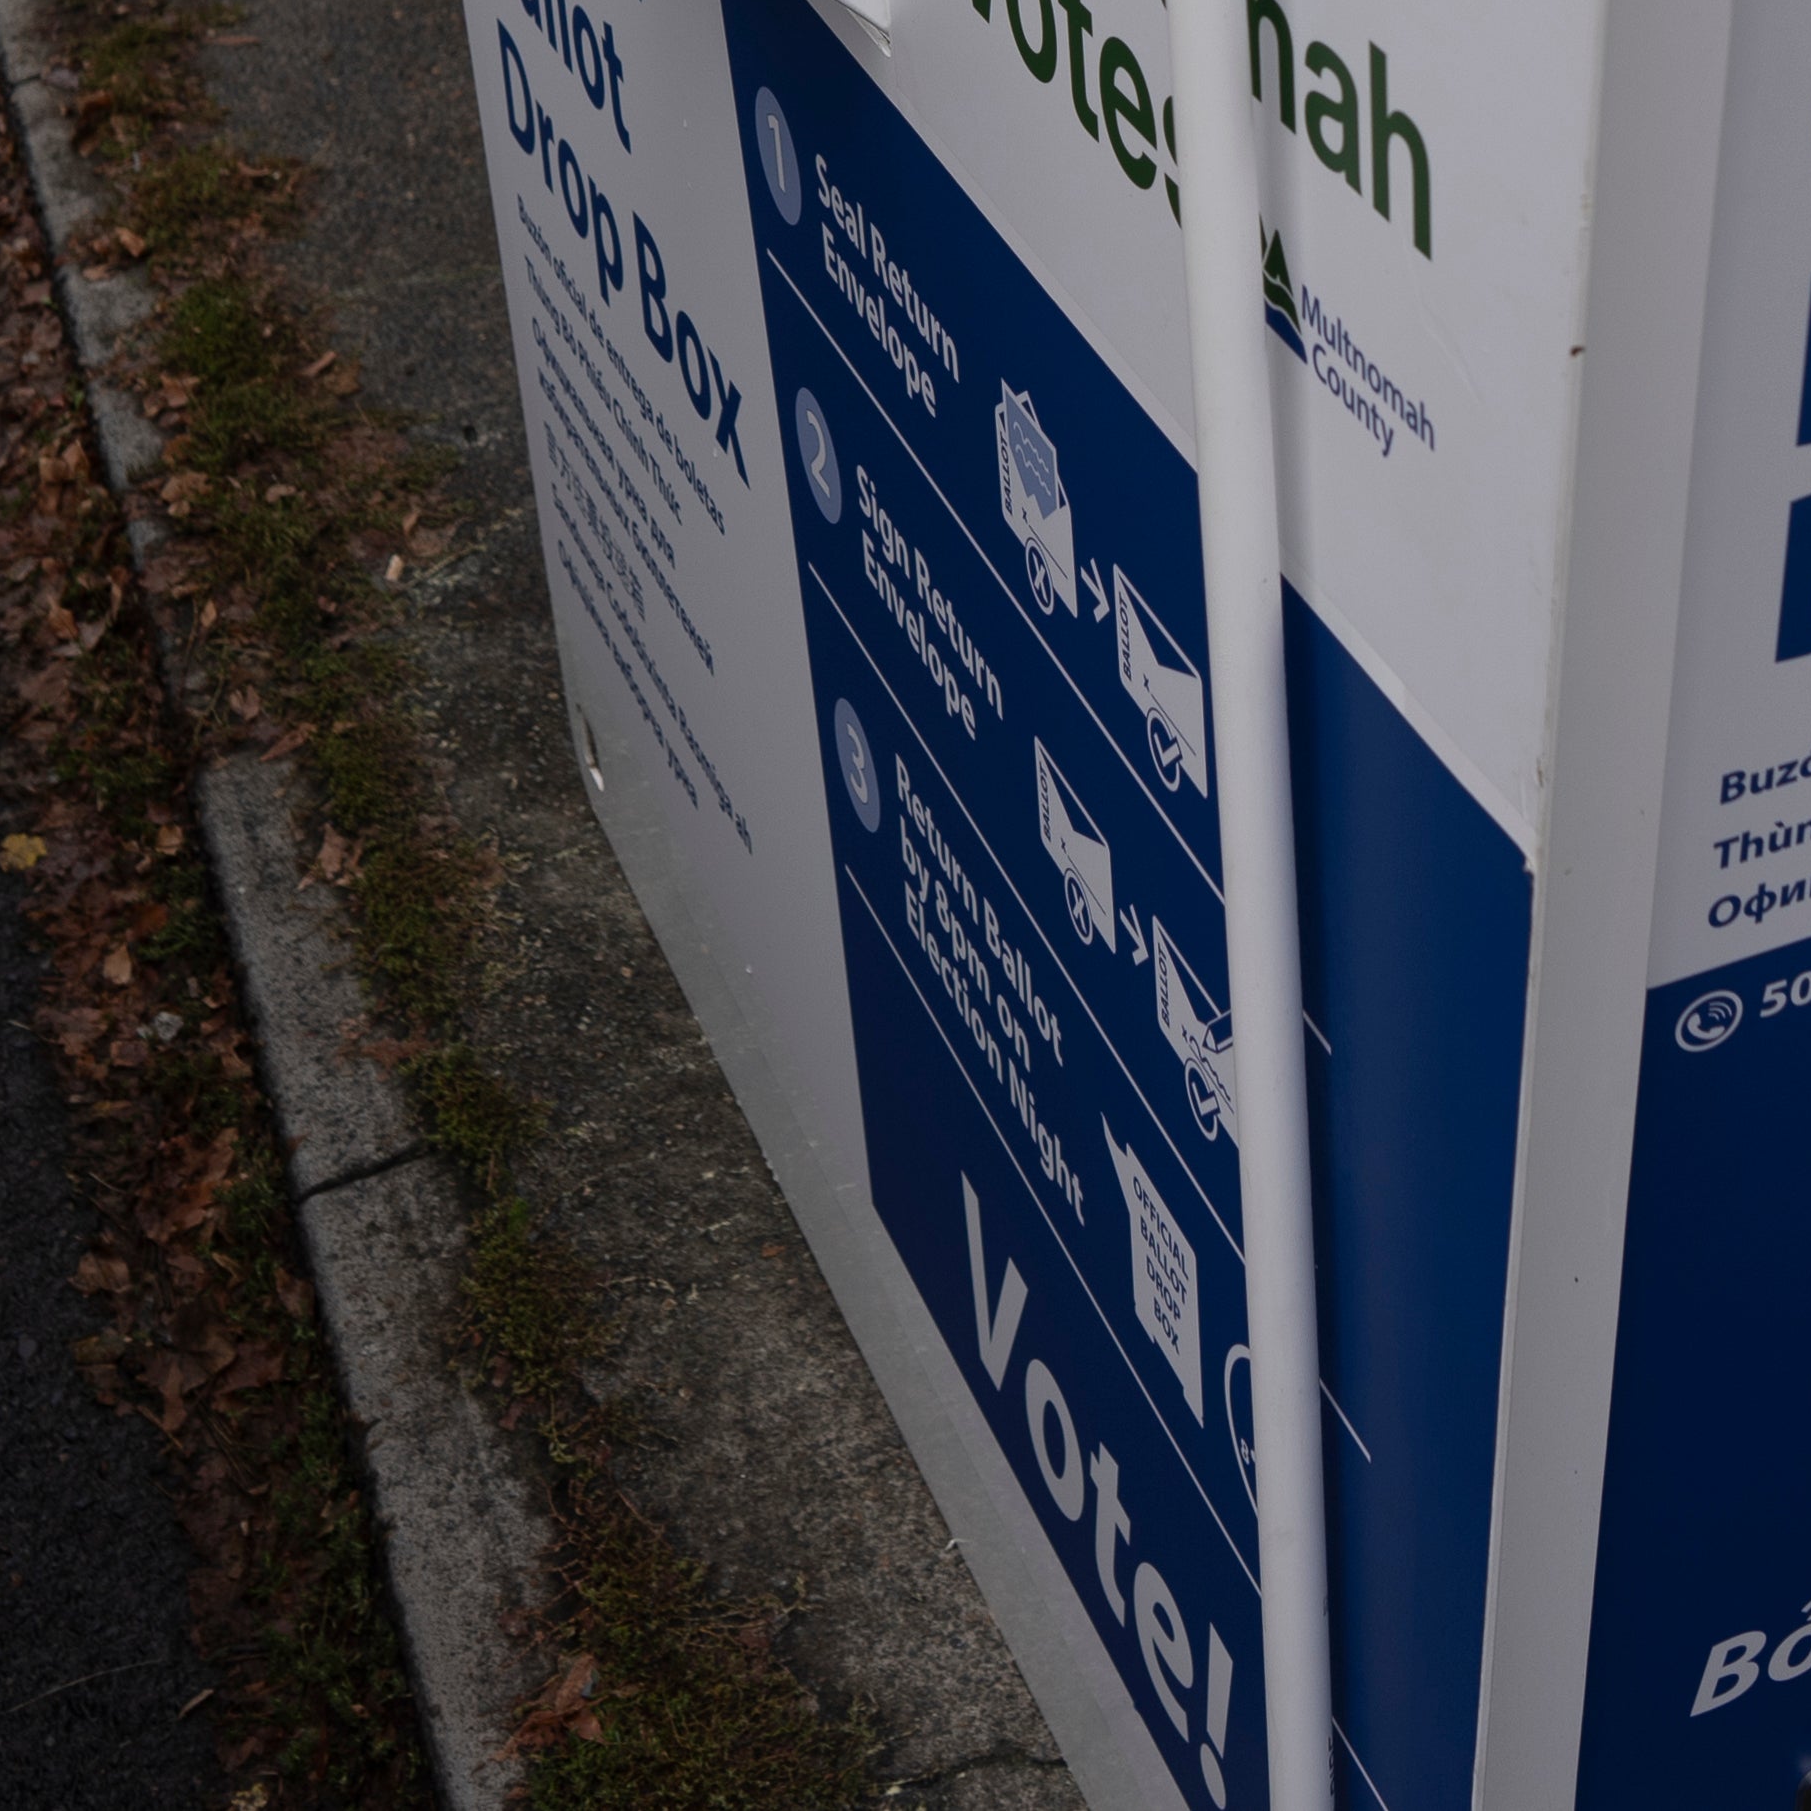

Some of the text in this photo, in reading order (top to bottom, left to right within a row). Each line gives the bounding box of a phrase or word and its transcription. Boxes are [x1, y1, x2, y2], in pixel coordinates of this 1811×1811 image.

[767, 113, 786, 193] 1
[496, 17, 751, 490] Drop Box
[814, 153, 960, 384] Seal Return
[517, 192, 726, 536] Buzón oficial de entrega de boletas
[821, 221, 936, 419] Envelope
[1301, 283, 1435, 452] Multnomah
[806, 409, 830, 499] 2
[1312, 346, 1395, 458] County
[998, 434, 1014, 516] BALLOT
[856, 464, 1003, 722] Sign Return
[862, 528, 976, 741] Envelope
[1118, 590, 1133, 682] BALLOT
[846, 723, 868, 805] 3
[1038, 758, 1052, 843] BALLOT
[895, 752, 1064, 1068] Return Ballot
[899, 814, 1031, 1072] by 8pm on
[1157, 940, 1171, 1029] BALLOT
[904, 879, 1085, 1228] Election Night
[1132, 1175, 1190, 1281] OFFICIAL
[1140, 1213, 1187, 1305] BALLOT
[1146, 1253, 1181, 1322] DROP
[1153, 1296, 1181, 1355] BOX
[960, 1168, 1235, 1811] Vote!
